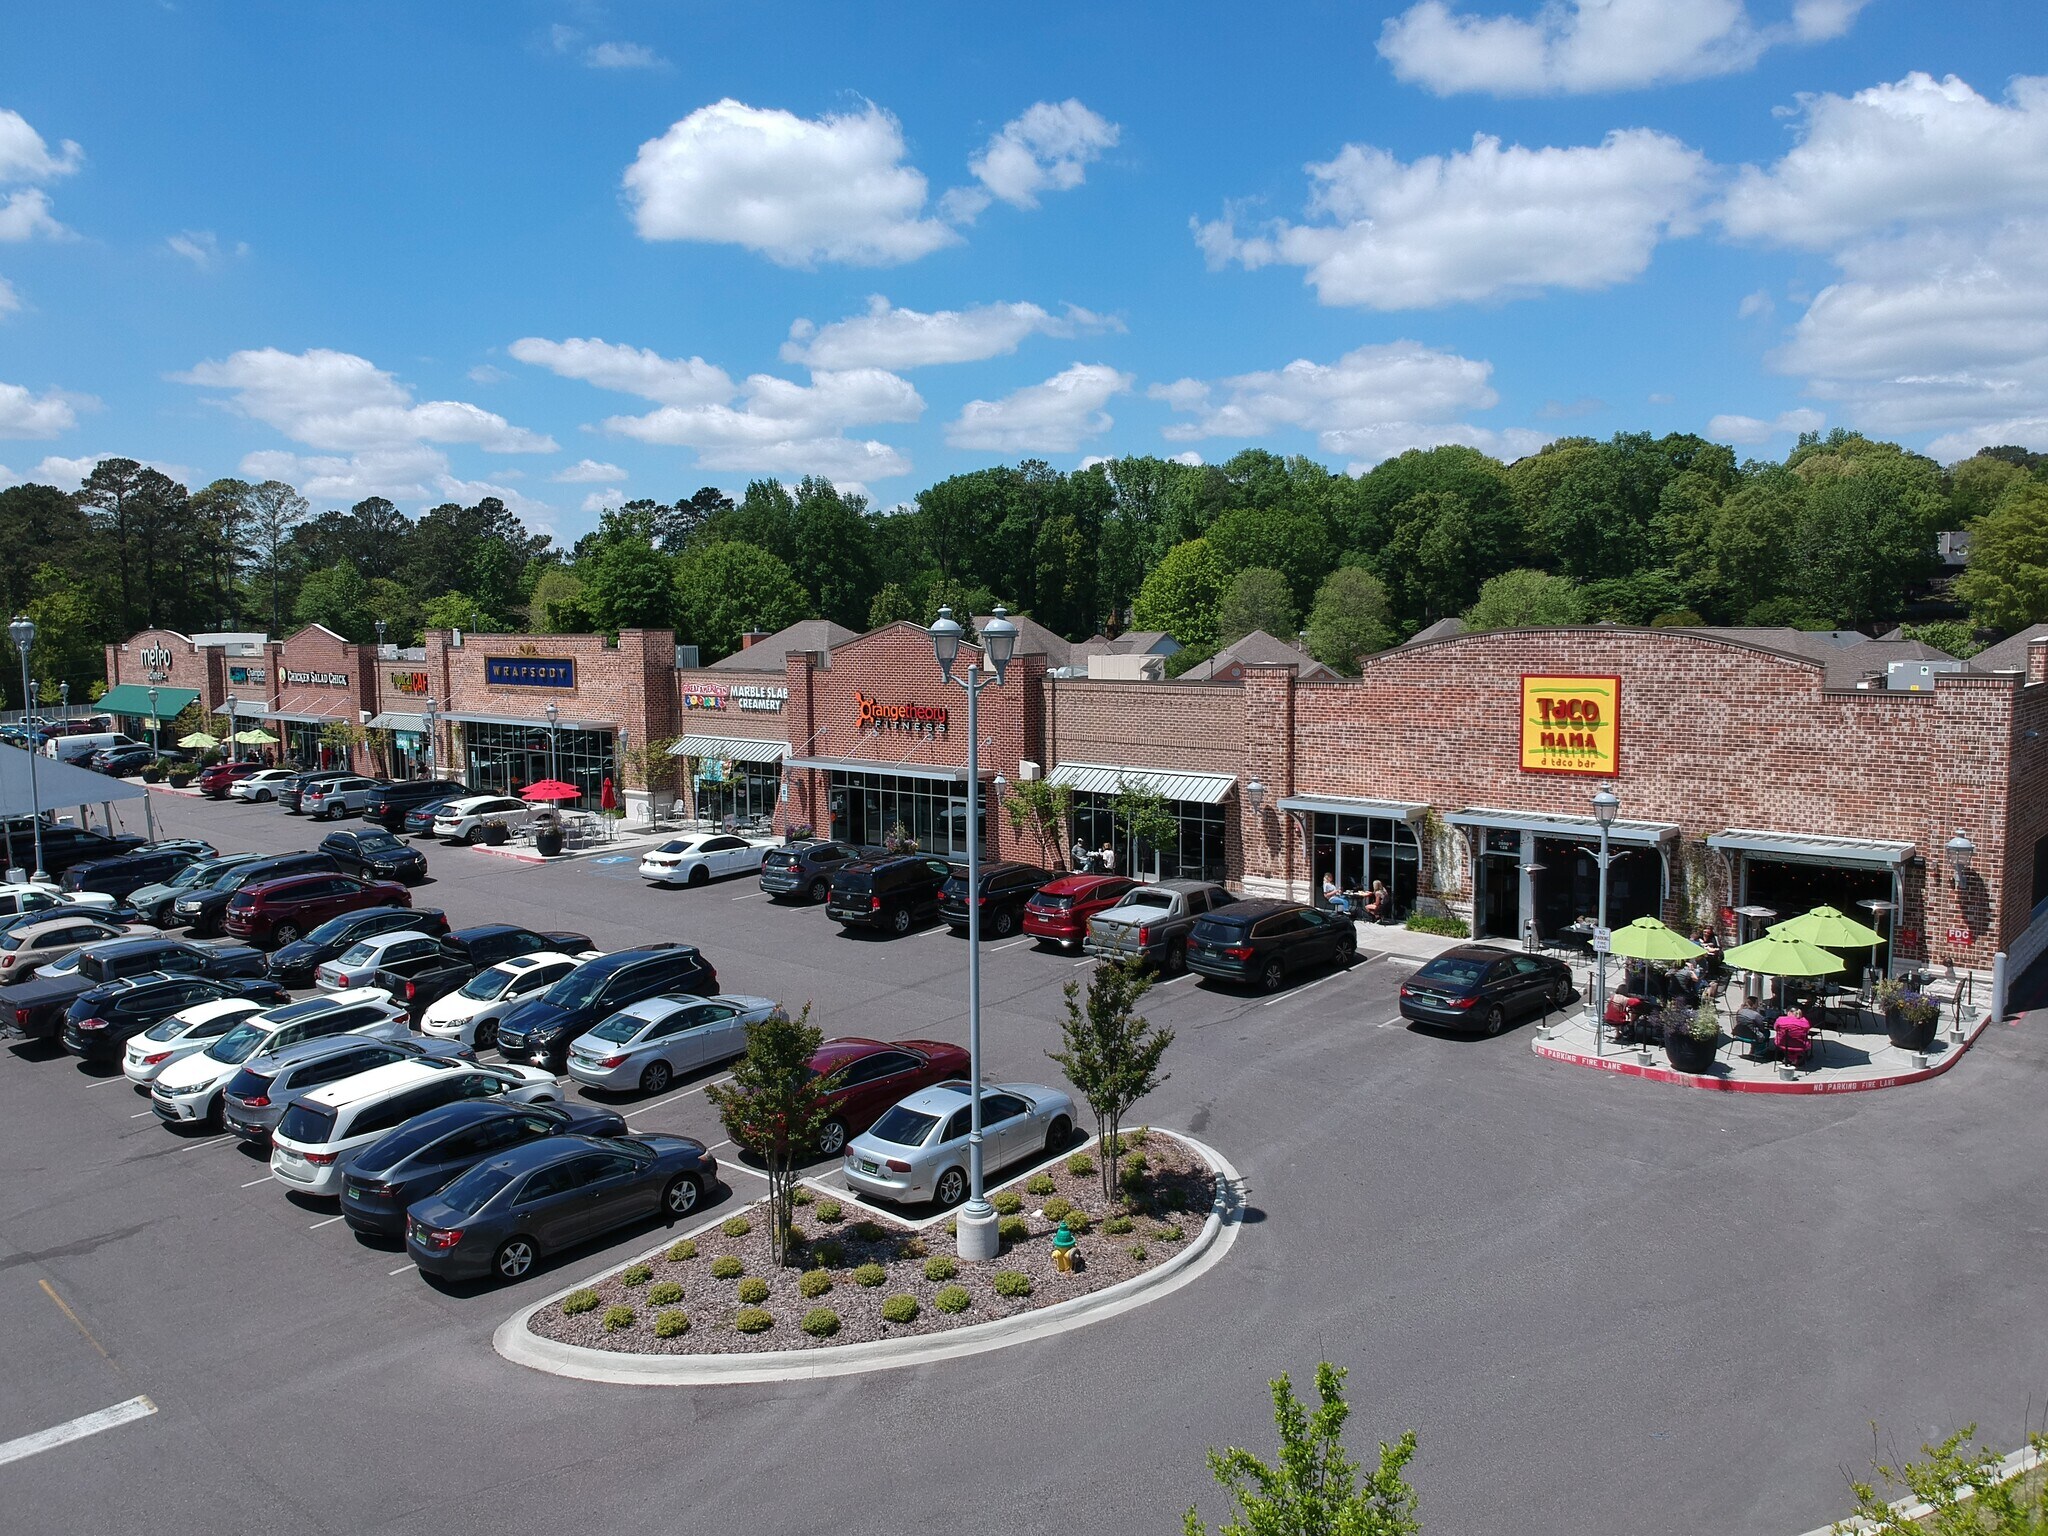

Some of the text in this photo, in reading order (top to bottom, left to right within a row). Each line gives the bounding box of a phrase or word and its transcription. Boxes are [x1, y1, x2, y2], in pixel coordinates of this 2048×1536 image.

[140, 640, 171, 667] metro
[287, 670, 310, 683] CHICKEN
[310, 671, 328, 684] SALAD
[492, 665, 566, 678] WRAPSODY
[730, 685, 788, 699] MARBLE SLAB
[738, 698, 781, 710] CREAMERY
[857, 695, 946, 725] Orangetheory
[875, 719, 946, 732] FITNESS
[1540, 731, 1598, 749] MAMA
[1551, 758, 1573, 768] taco
[1577, 758, 1596, 769] bar
[1949, 929, 1969, 939] FDC
[1537, 1046, 1622, 1071] NO PARKING FIRE LANE
[1813, 1078, 1896, 1092] NO PARKING FIRE LANE
